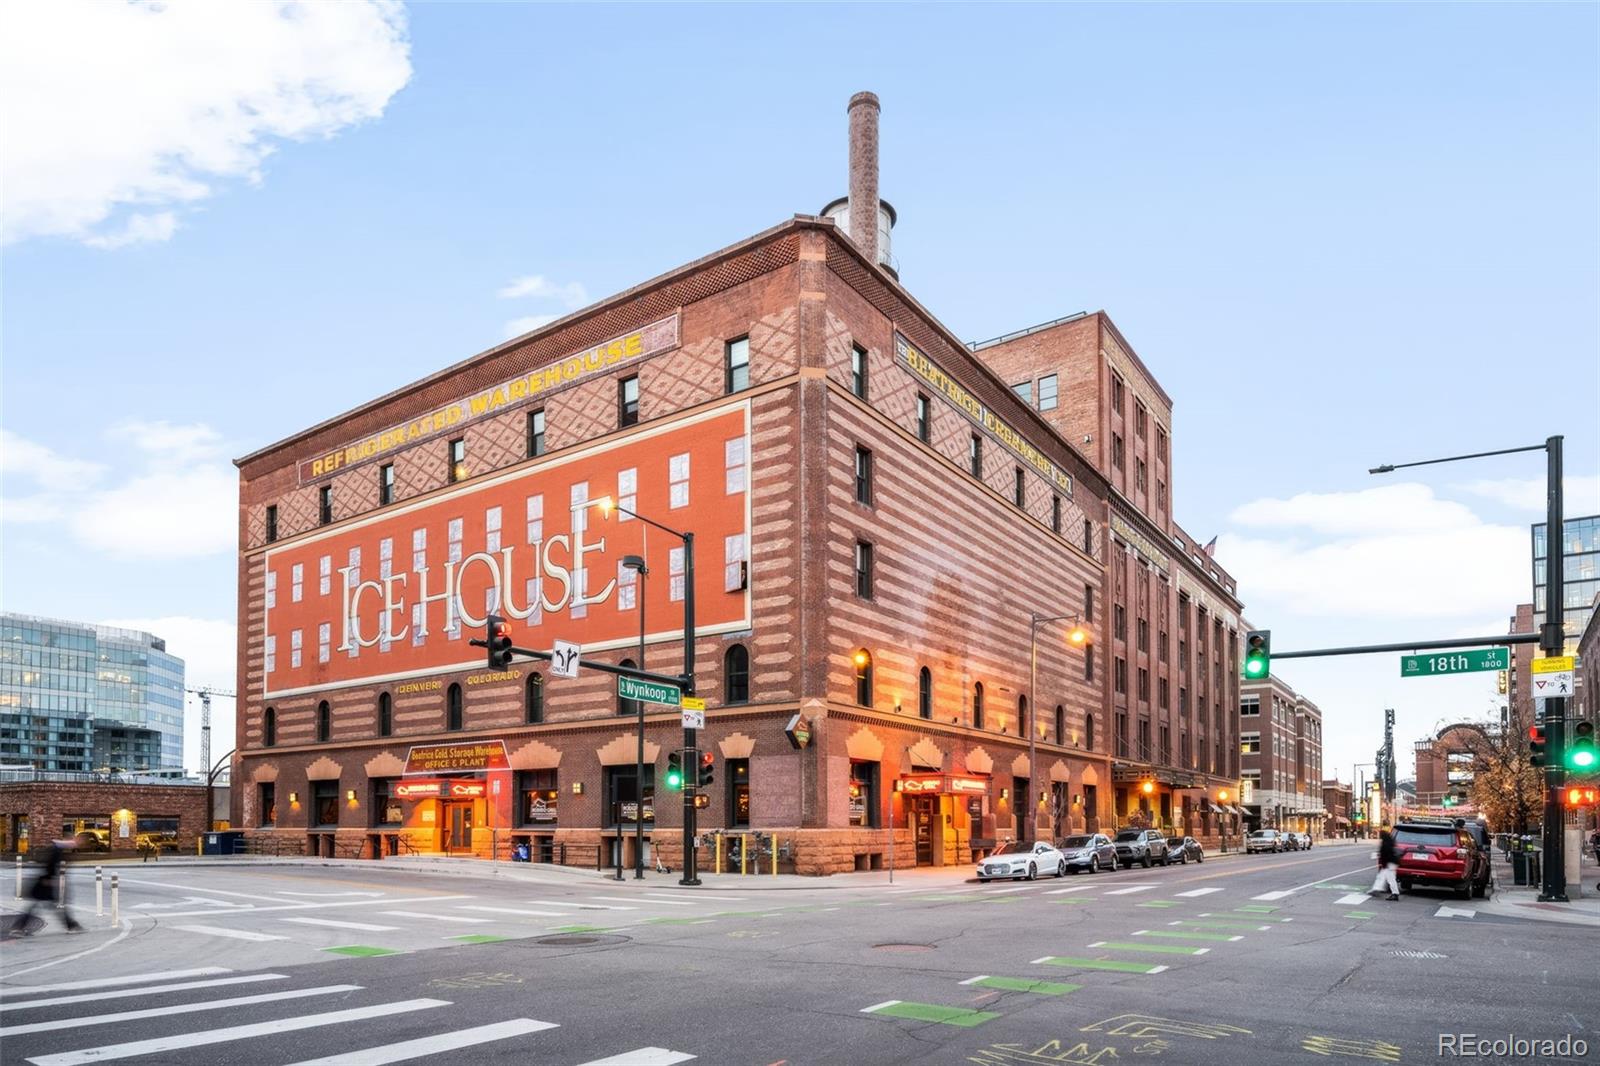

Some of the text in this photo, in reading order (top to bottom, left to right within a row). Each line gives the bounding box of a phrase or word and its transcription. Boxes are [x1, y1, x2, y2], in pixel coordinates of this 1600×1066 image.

[312, 332, 643, 477] REFRIGERATED WAREHOUSE
[1428, 655, 1469, 672] 18th
[1481, 660, 1502, 668] 1800
[467, 671, 520, 686] COLORADO
[399, 681, 439, 694] DENVER
[626, 681, 667, 703] Wynkoop
[424, 760, 450, 769] OFFICE
[460, 758, 486, 767] PLANT
